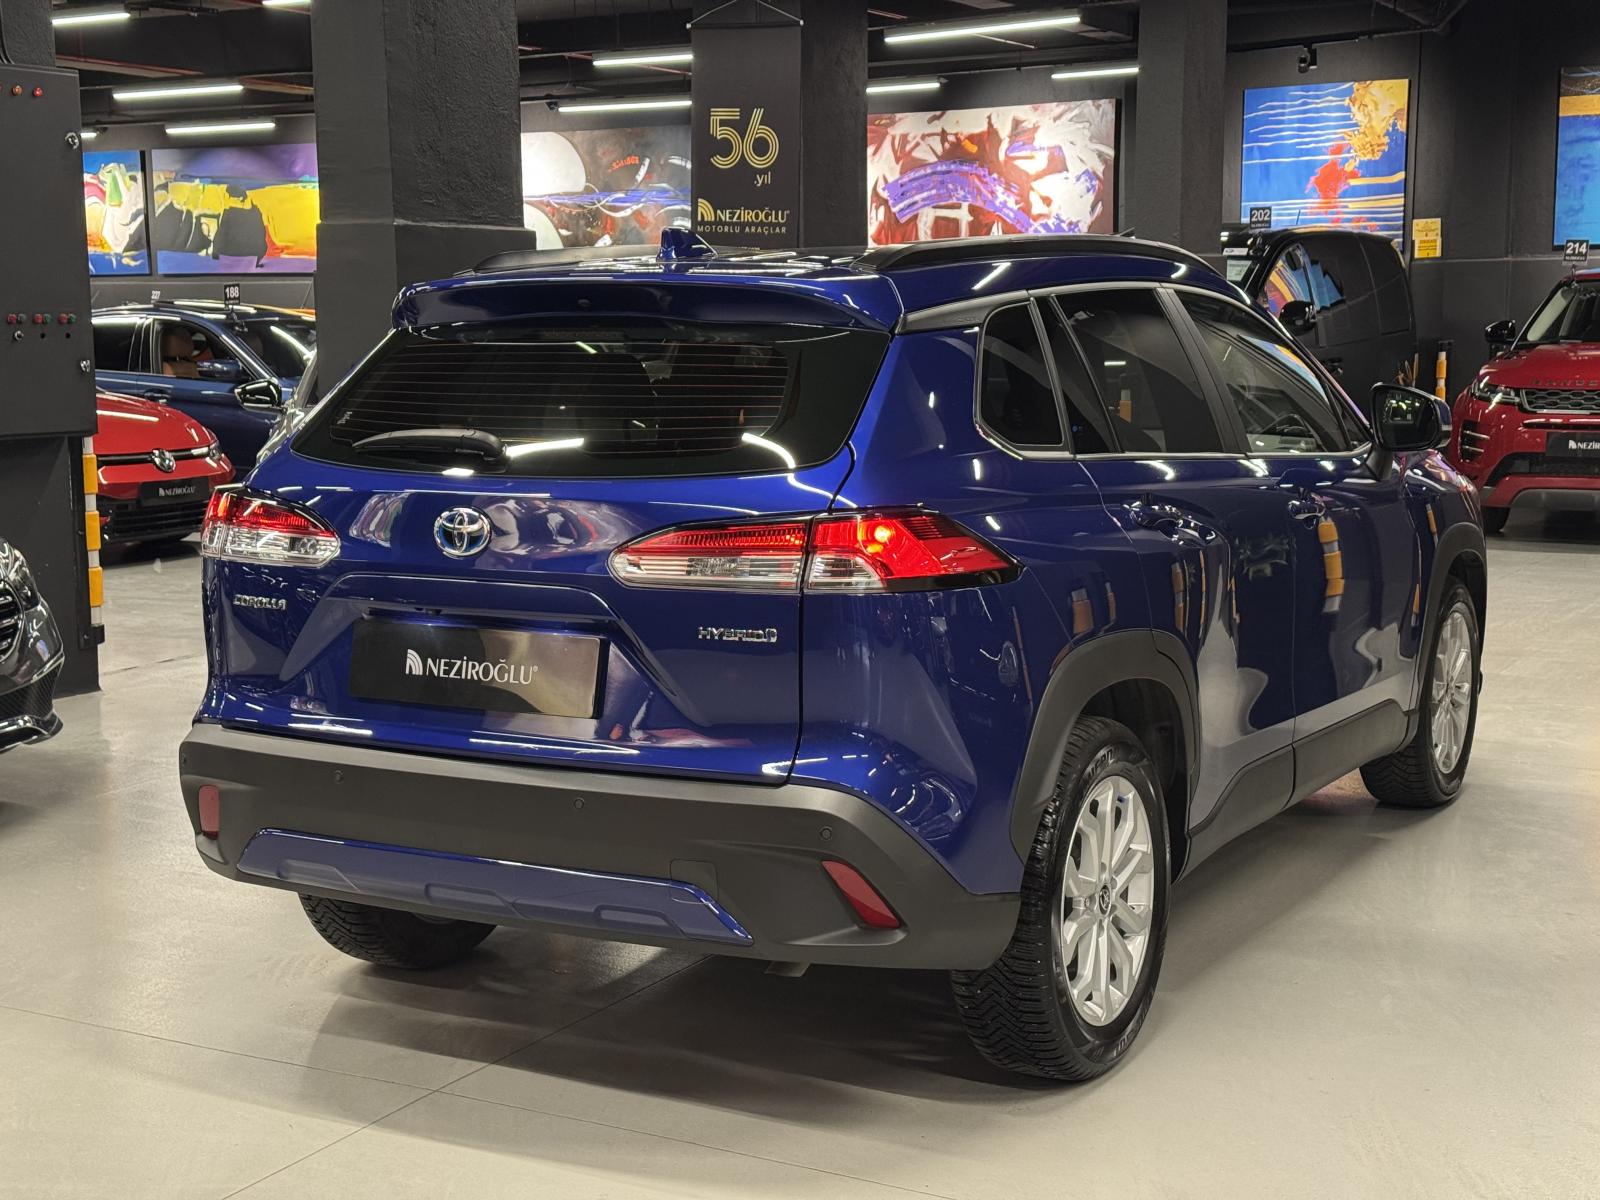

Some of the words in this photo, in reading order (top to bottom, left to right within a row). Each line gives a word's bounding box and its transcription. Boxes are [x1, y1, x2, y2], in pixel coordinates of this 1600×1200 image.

[710, 108, 779, 169] 56
[716, 206, 787, 223] NEZİROĞLU
[1251, 209, 1270, 222] 202
[697, 225, 740, 233] MOTORLU
[744, 226, 786, 235] ARAÇLAR
[1566, 242, 1587, 254] 214
[225, 286, 239, 299] 188
[426, 656, 534, 685] NEZİROĞLU
